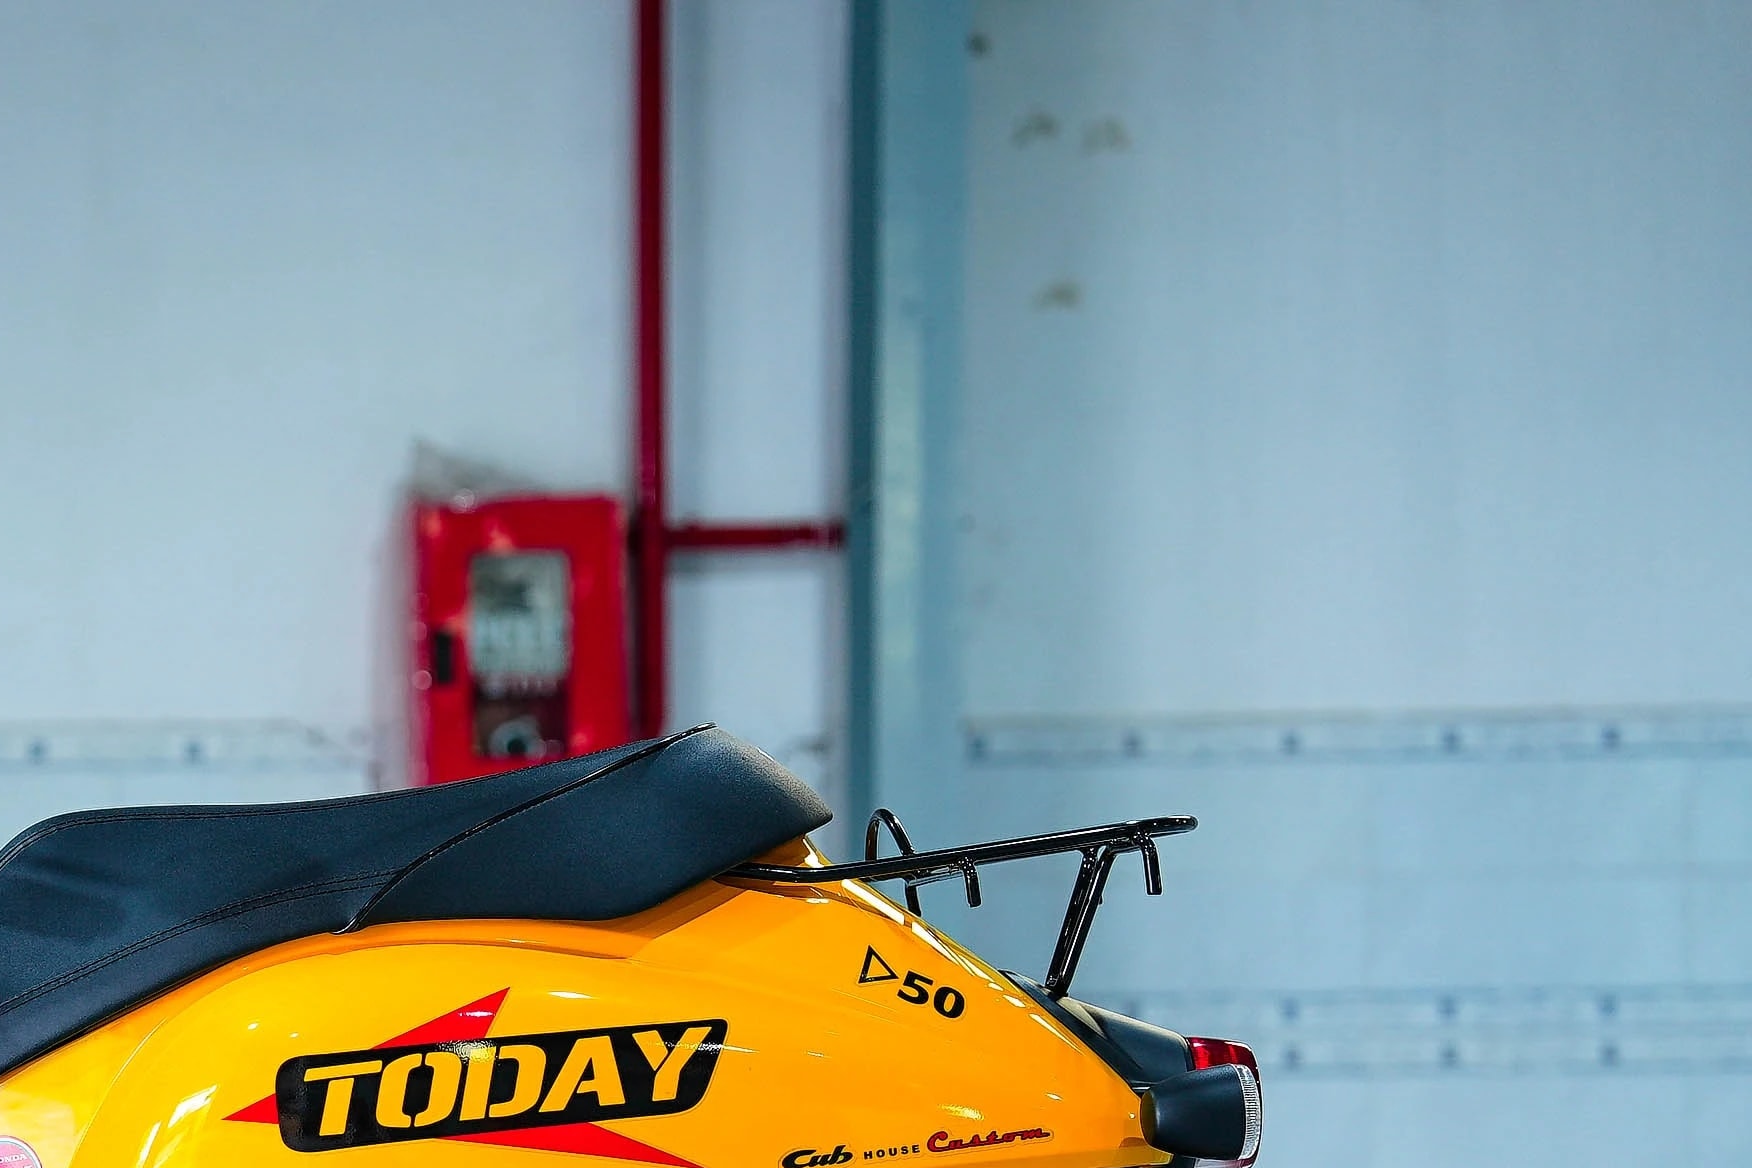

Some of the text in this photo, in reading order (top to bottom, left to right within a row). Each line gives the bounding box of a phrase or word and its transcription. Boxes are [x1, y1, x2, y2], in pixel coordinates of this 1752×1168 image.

[303, 1026, 712, 1137] TODAY
[863, 1143, 921, 1160] HOUSE
[926, 1127, 1051, 1153] Custom
